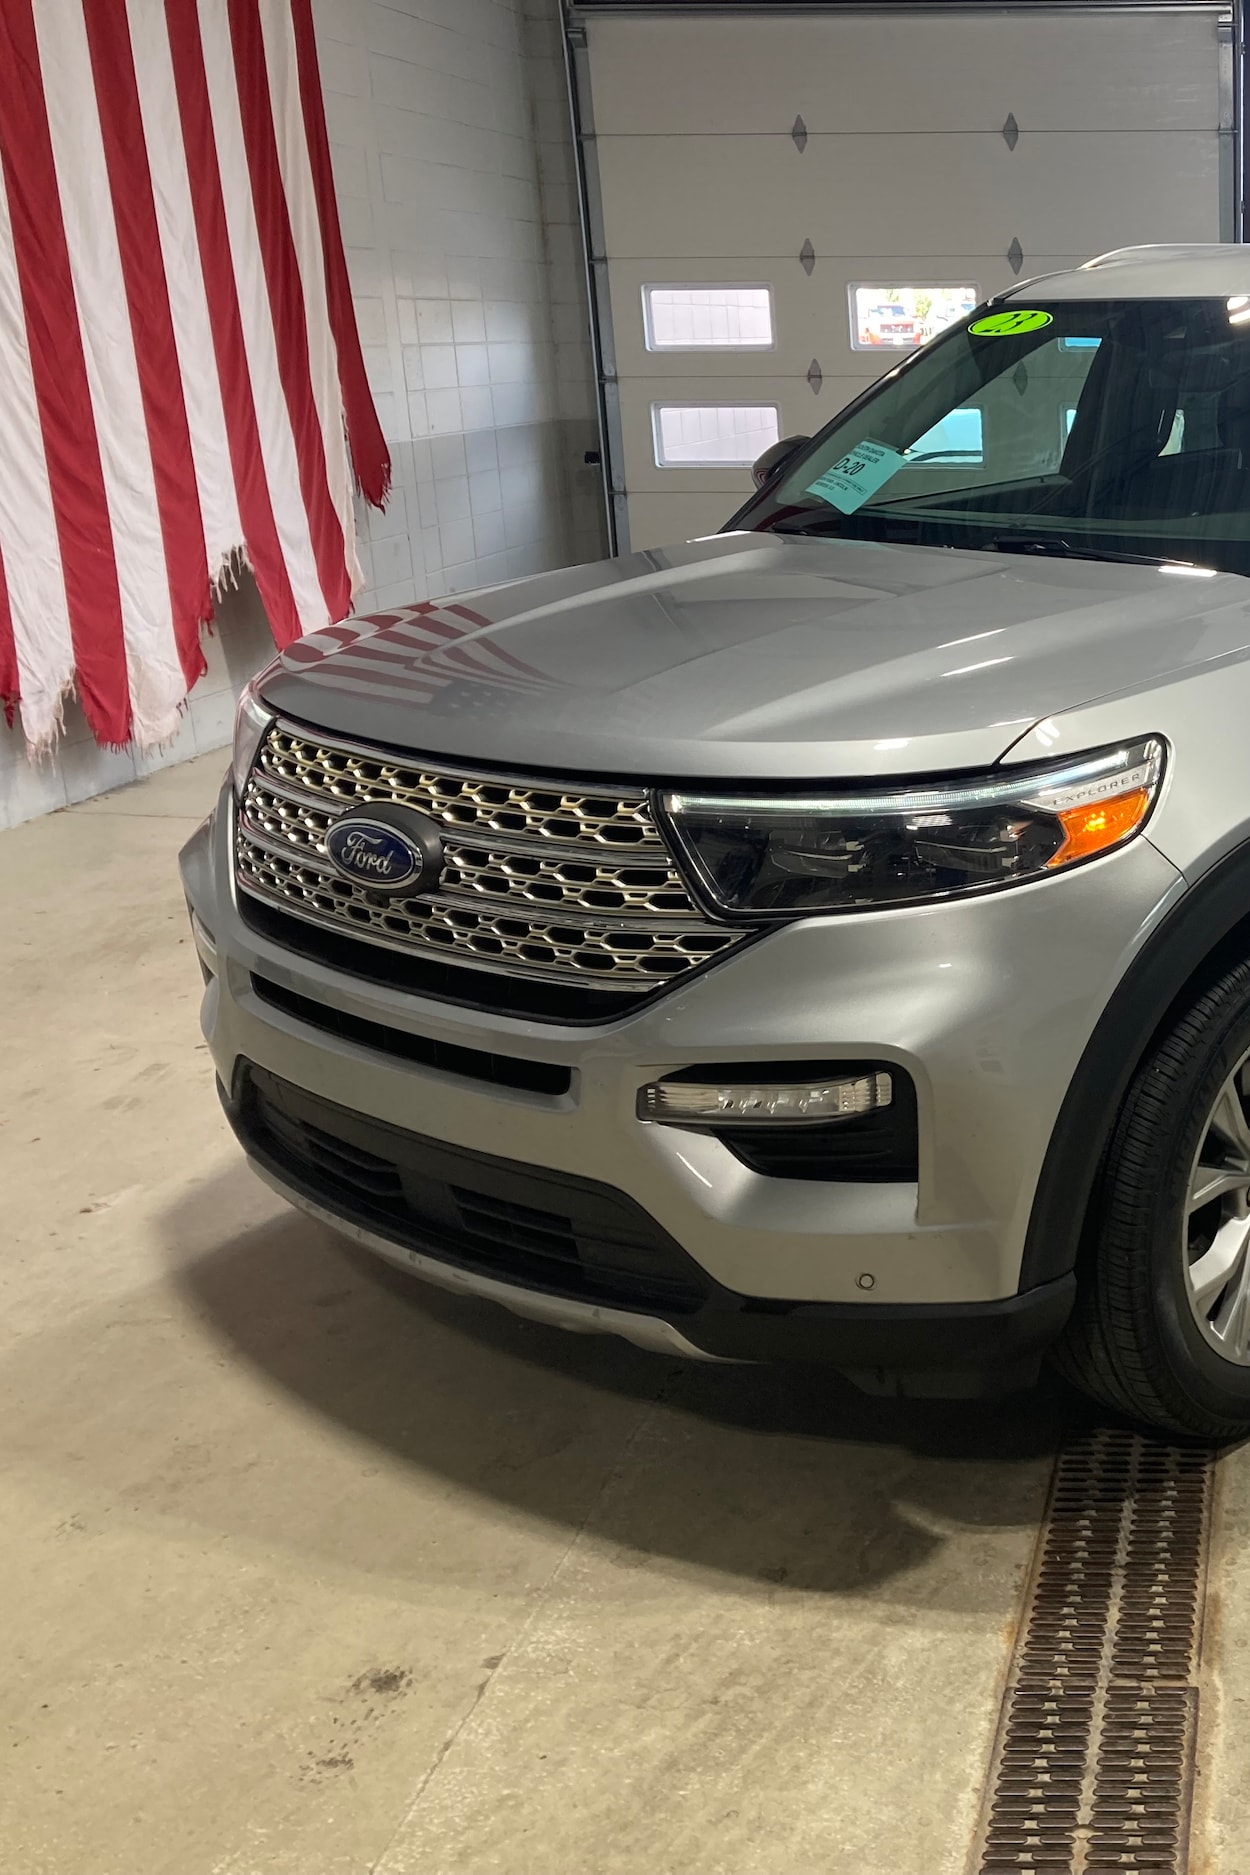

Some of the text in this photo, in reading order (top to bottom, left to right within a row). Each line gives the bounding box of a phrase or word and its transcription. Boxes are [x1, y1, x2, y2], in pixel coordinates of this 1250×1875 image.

[980, 313, 1038, 333] 23
[833, 457, 866, 476] D-20
[1053, 773, 1140, 806] EXPLORER
[341, 831, 394, 875] Ford
